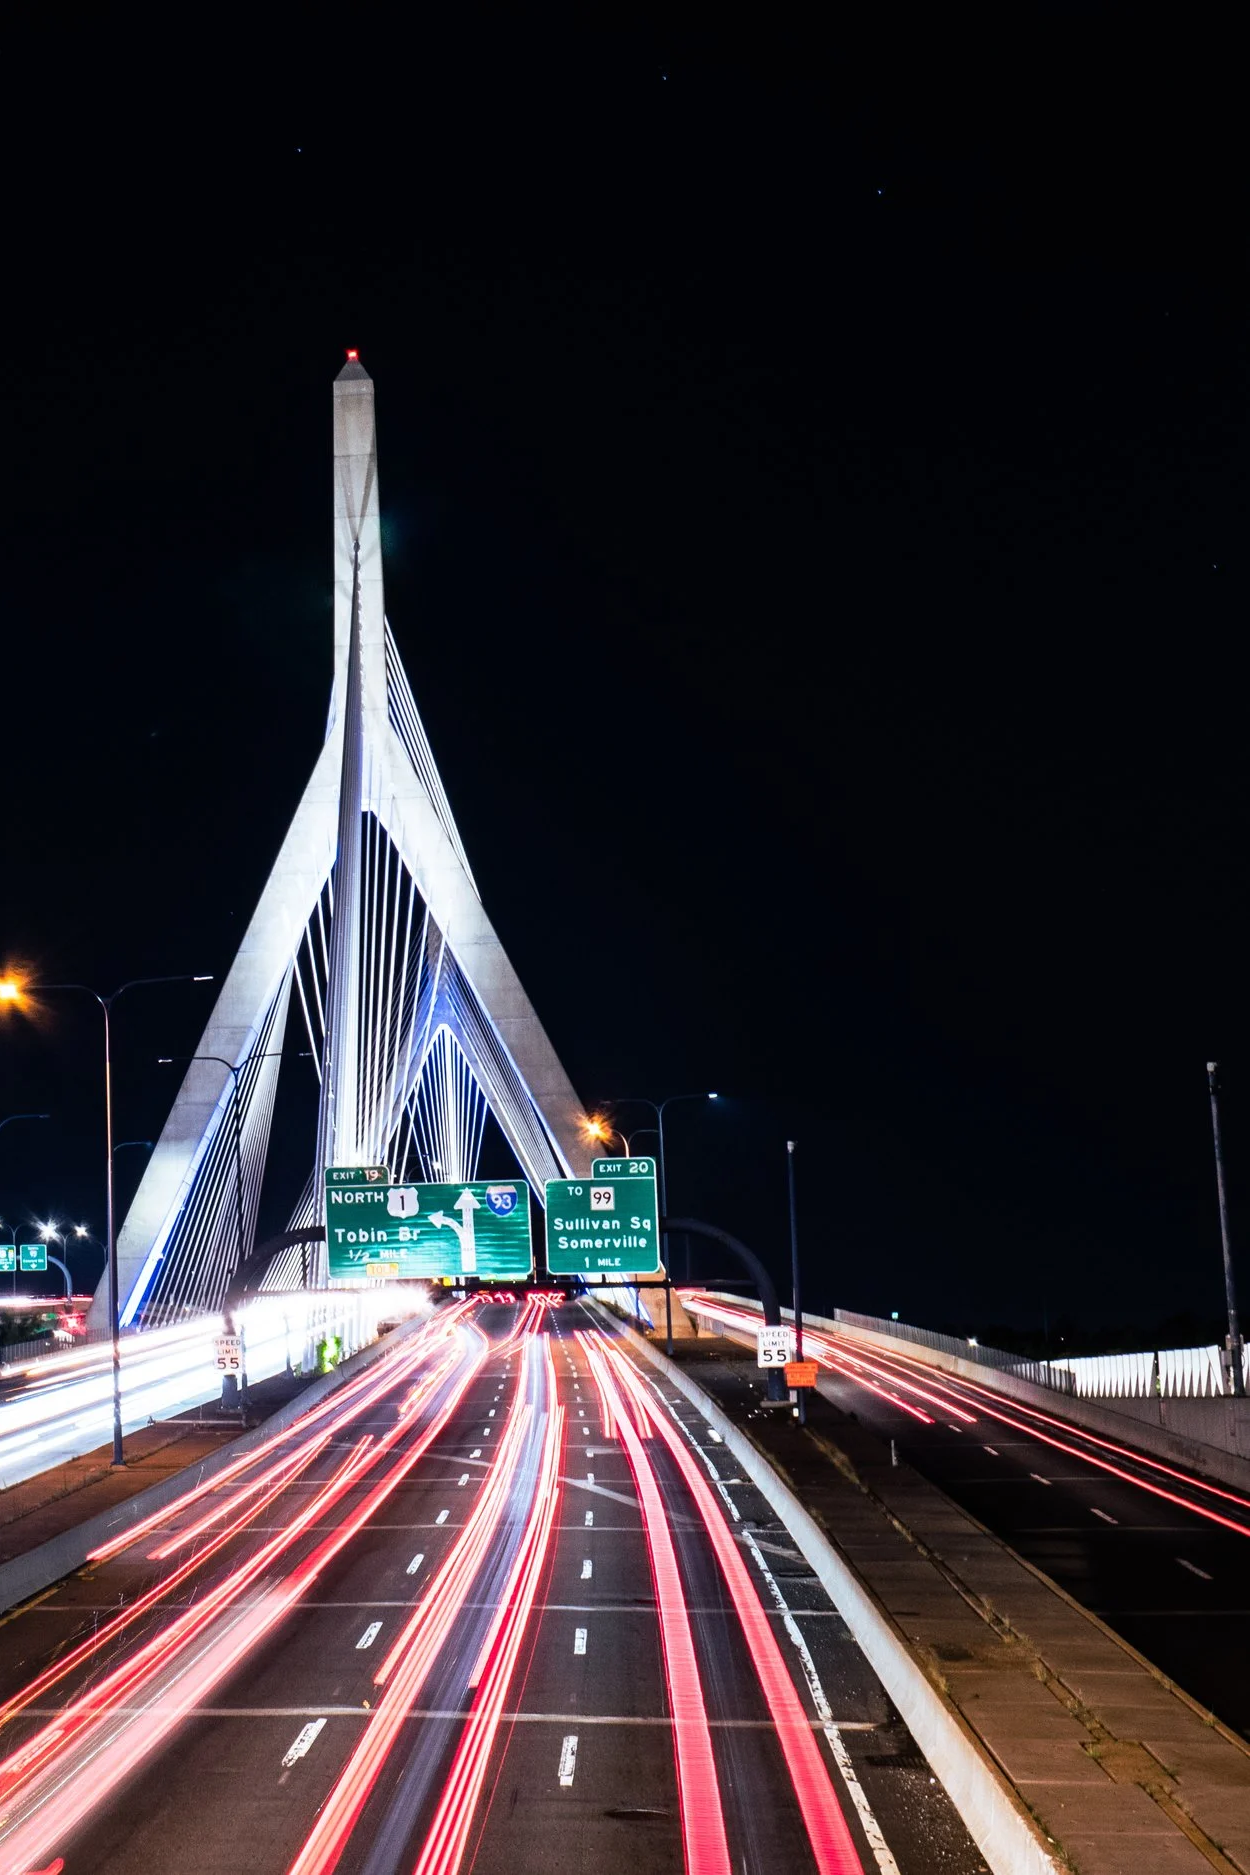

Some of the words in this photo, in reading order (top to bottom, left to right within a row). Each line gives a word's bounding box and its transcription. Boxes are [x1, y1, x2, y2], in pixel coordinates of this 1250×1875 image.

[599, 1164, 622, 1173] EXIT
[629, 1162, 649, 1173] 20
[333, 1172, 356, 1180] EXIT
[364, 1169, 379, 1181] 19
[331, 1191, 384, 1204] NORTH
[399, 1195, 405, 1211] 1
[491, 1194, 512, 1210] 93
[567, 1186, 583, 1196] TO
[593, 1191, 611, 1205] 99
[553, 1217, 621, 1231] Sullivan
[630, 1216, 651, 1232] Sq
[334, 1228, 388, 1243] Tobin
[398, 1226, 421, 1242] Br
[558, 1235, 647, 1249] Somerville
[349, 1249, 370, 1262] 1/2
[380, 1249, 408, 1259] MILE
[584, 1256, 590, 1269] 1
[597, 1257, 622, 1267] MILE
[763, 1349, 787, 1362] 55
[217, 1357, 240, 1370] 55
